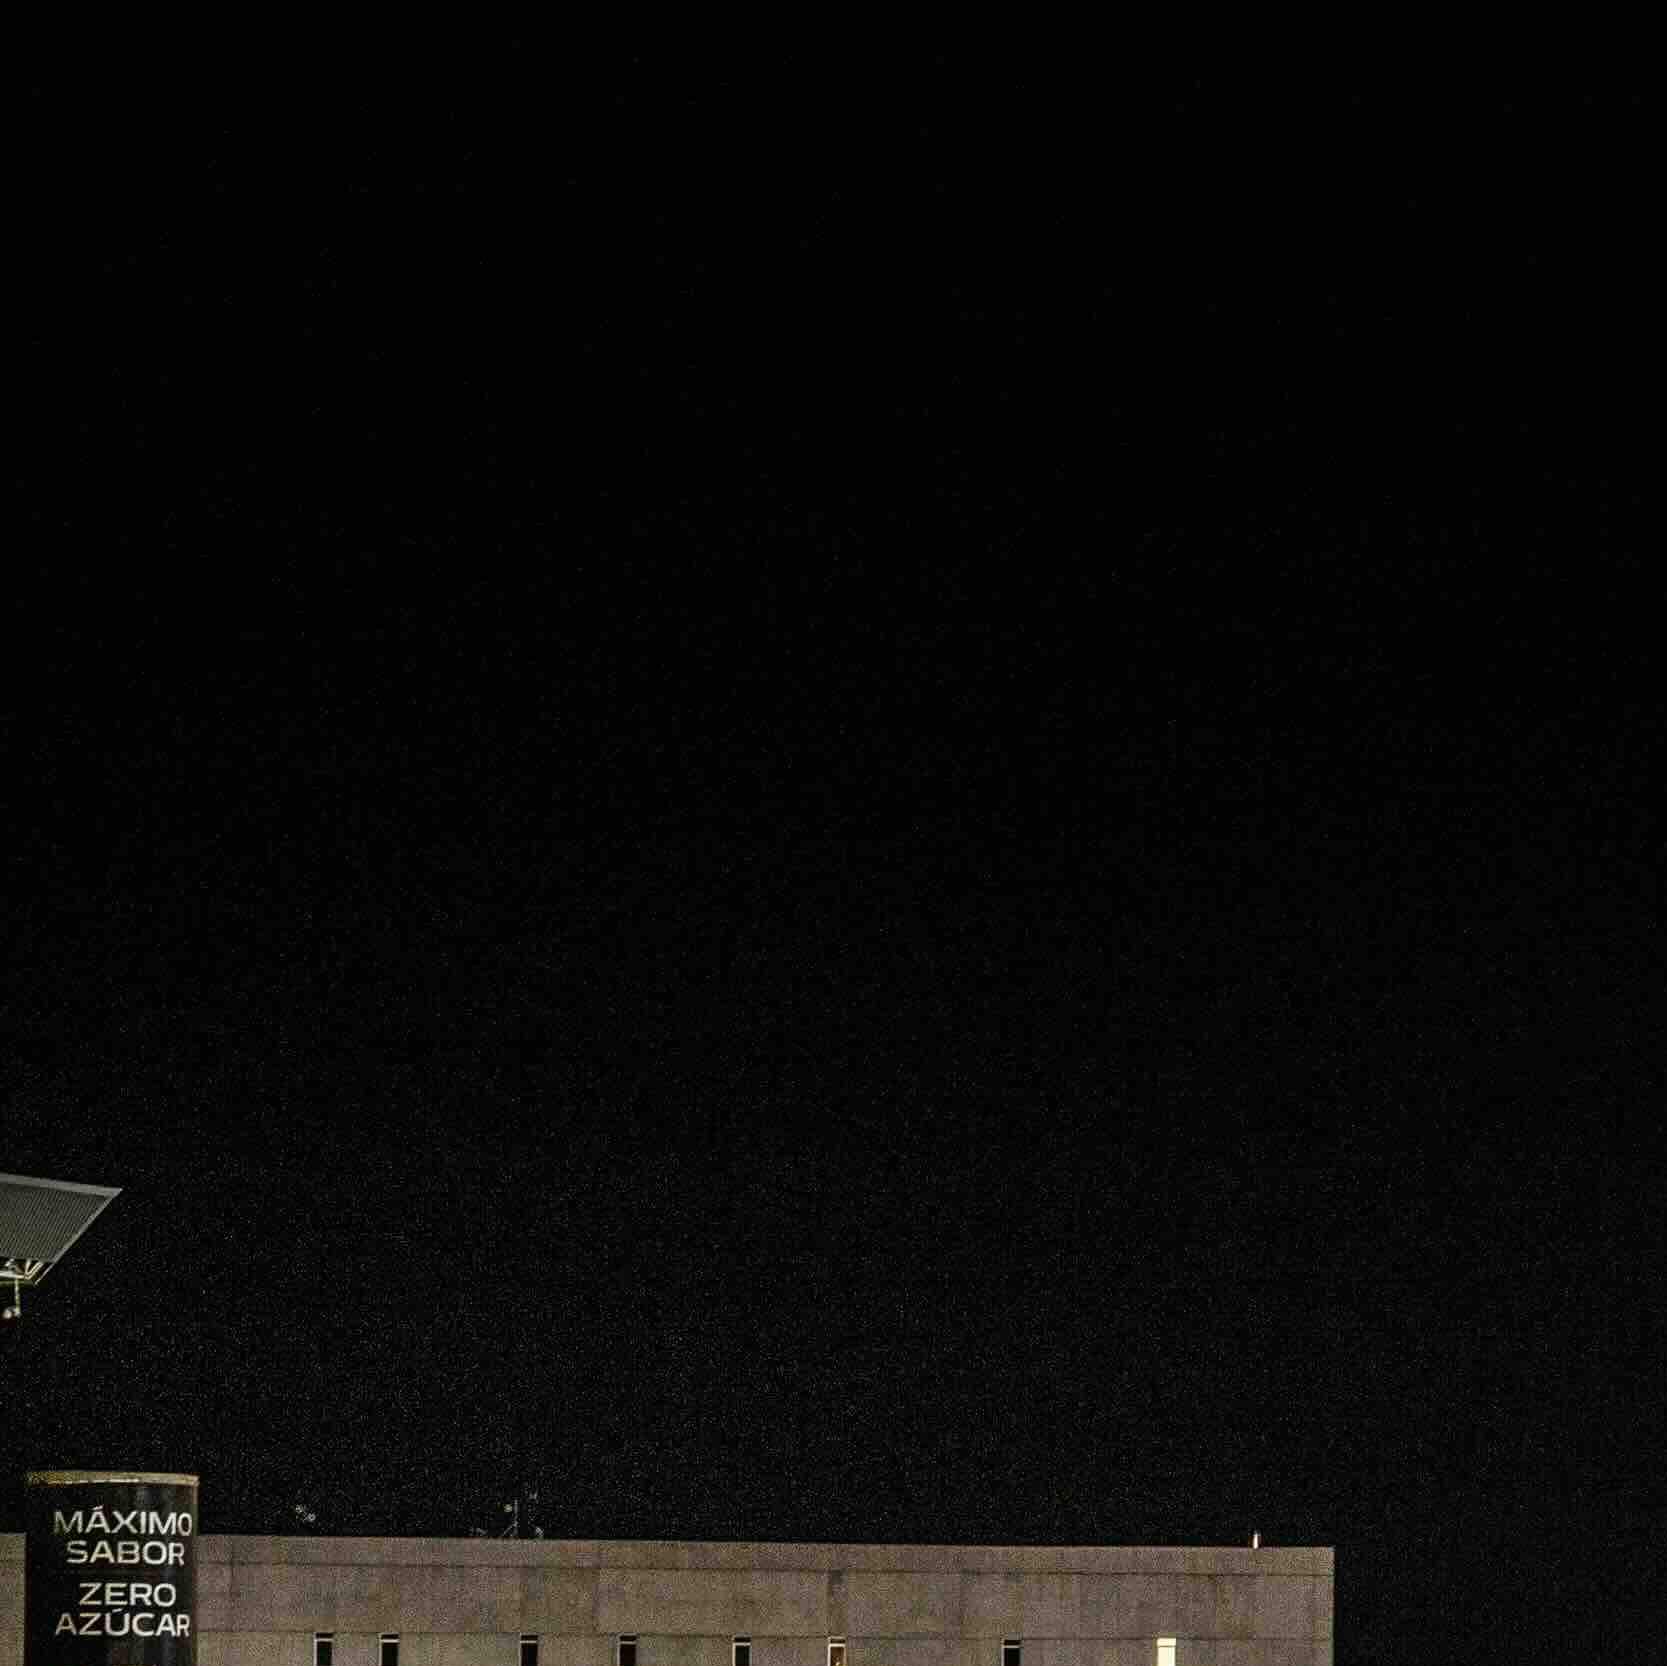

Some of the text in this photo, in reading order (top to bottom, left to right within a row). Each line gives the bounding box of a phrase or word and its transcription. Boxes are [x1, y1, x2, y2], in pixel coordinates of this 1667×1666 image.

[53, 1505, 193, 1537] MÁXIMO
[66, 1540, 185, 1566] SABOR
[79, 1583, 177, 1606] ZERO
[55, 1608, 191, 1638] AZÚCAR
